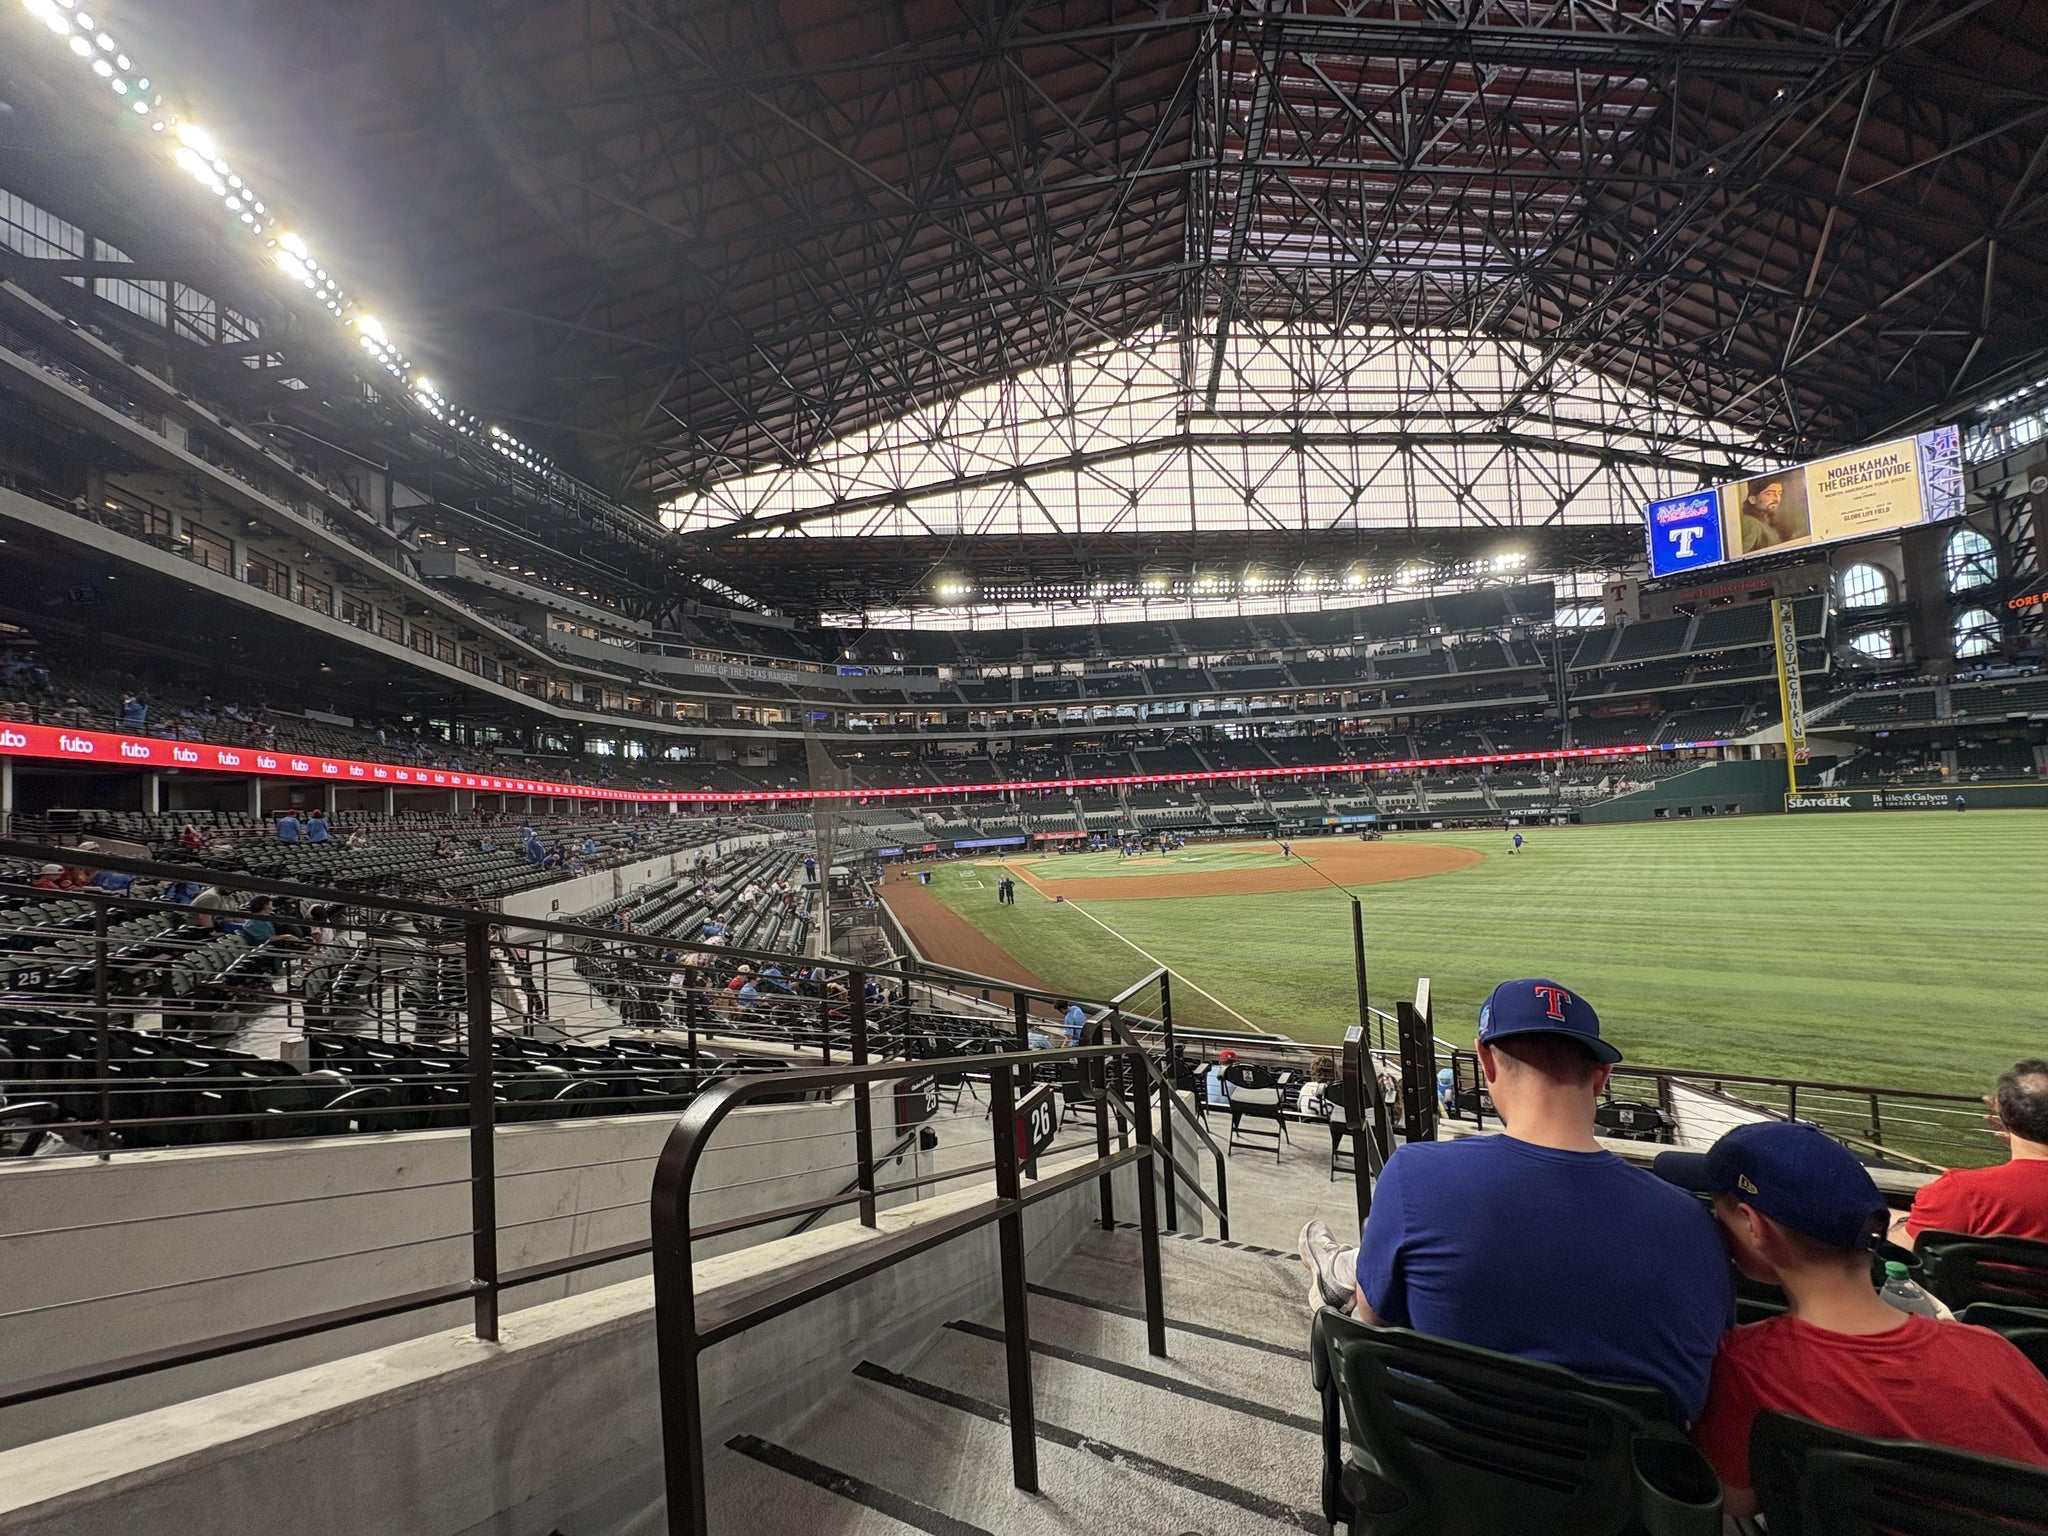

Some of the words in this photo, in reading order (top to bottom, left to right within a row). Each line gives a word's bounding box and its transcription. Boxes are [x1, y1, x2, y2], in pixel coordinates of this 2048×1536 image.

[1818, 479, 1842, 493] THE
[1840, 470, 1876, 488] GREAT
[1874, 461, 1912, 480] DIVIDE
[1828, 463, 1858, 480] NOAH
[1858, 453, 1898, 472] KAHAN
[1874, 506, 1890, 515] FIELD
[1668, 526, 1704, 558] T
[1610, 584, 1627, 601] T
[2008, 594, 2039, 610] CORE
[694, 663, 717, 676] HOME
[718, 666, 729, 676] OF
[730, 667, 744, 678] THE
[745, 668, 767, 680] TEXAS
[768, 670, 799, 683] RANGERS
[1787, 664, 1797, 676] 4
[1789, 681, 1802, 737] CHIKIN
[59, 734, 94, 754] fubo
[120, 741, 150, 759] fubo
[172, 746, 199, 763] fubo
[217, 751, 240, 766] fubo
[256, 755, 277, 769] fubo
[291, 758, 309, 772] fubo
[321, 761, 338, 774] fubo
[349, 765, 364, 777] fubo
[1788, 797, 1852, 808] SEATGEEK
[17, 971, 41, 987] 25
[1534, 986, 1573, 1023] T
[925, 1089, 937, 1112] 25
[1031, 1101, 1050, 1146] 26
